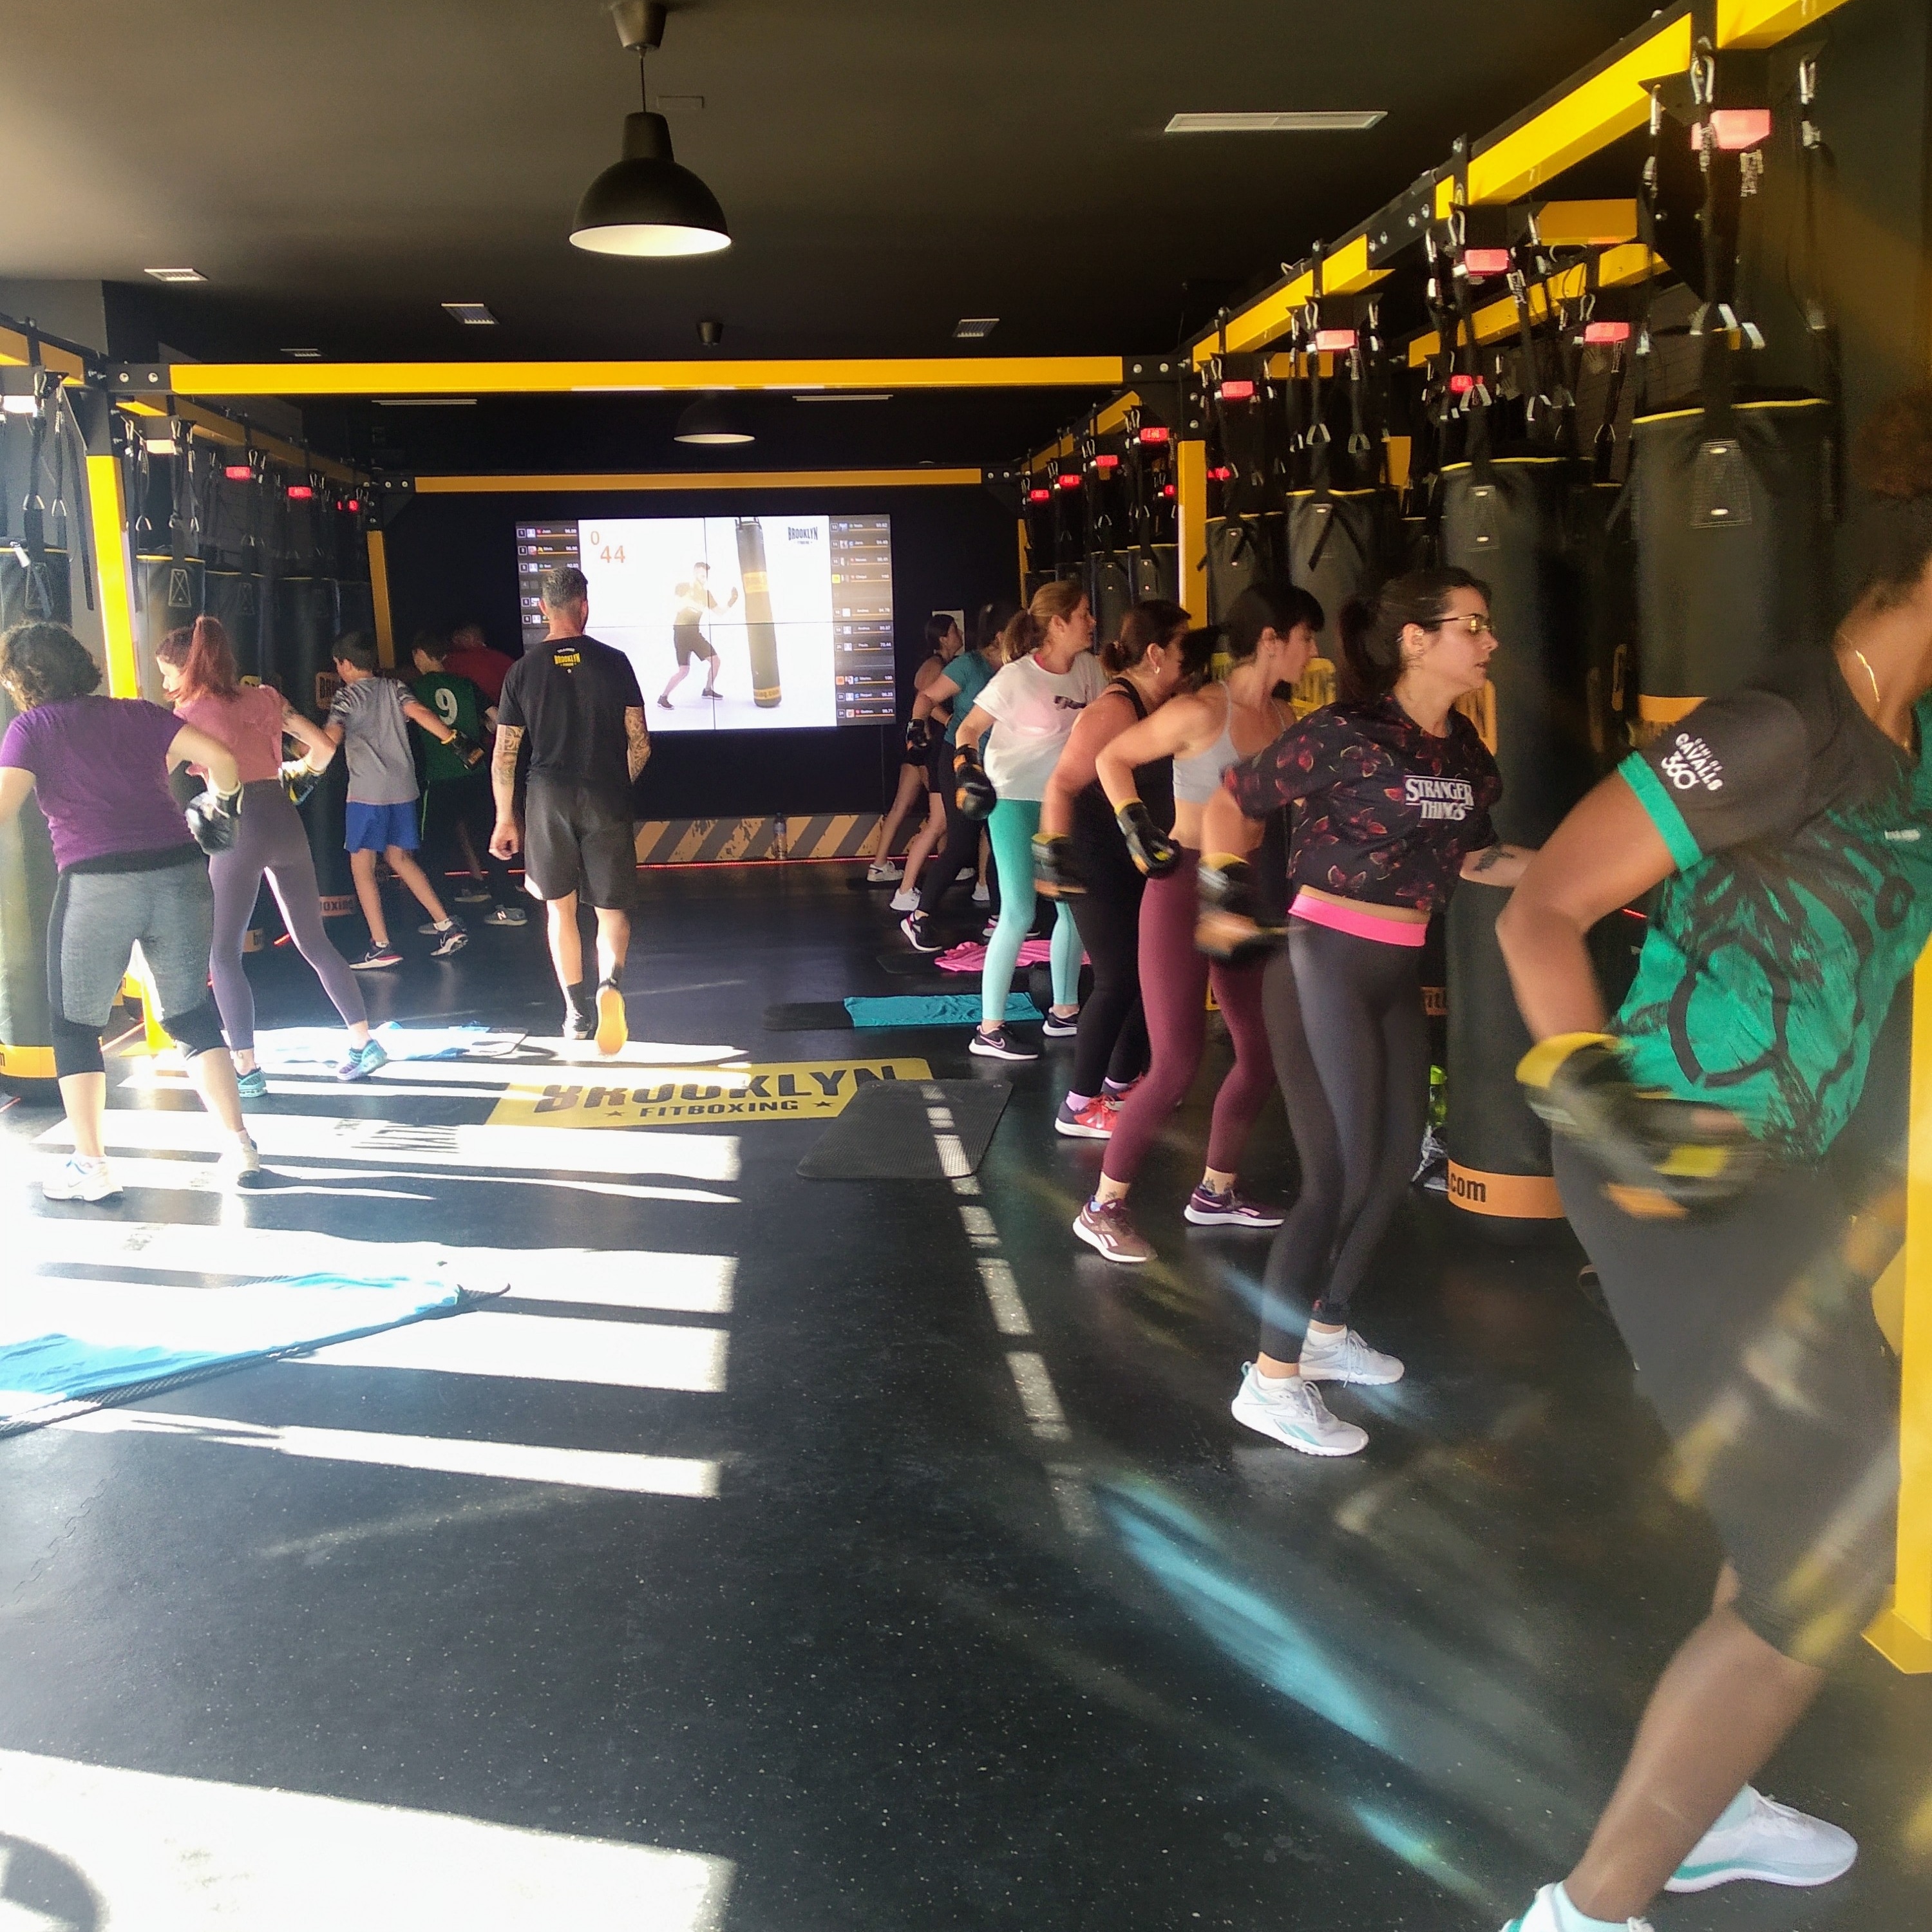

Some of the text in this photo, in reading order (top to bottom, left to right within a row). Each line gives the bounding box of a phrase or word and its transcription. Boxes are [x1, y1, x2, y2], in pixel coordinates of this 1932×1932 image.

[591, 531, 600, 545] 0
[788, 527, 818, 540] BROOKLYN
[600, 545, 625, 564] 44
[435, 688, 458, 725] 9
[1405, 778, 1474, 806] STRANGER
[1420, 800, 1466, 820] THINGS
[639, 1099, 799, 1118] FITBOXING
